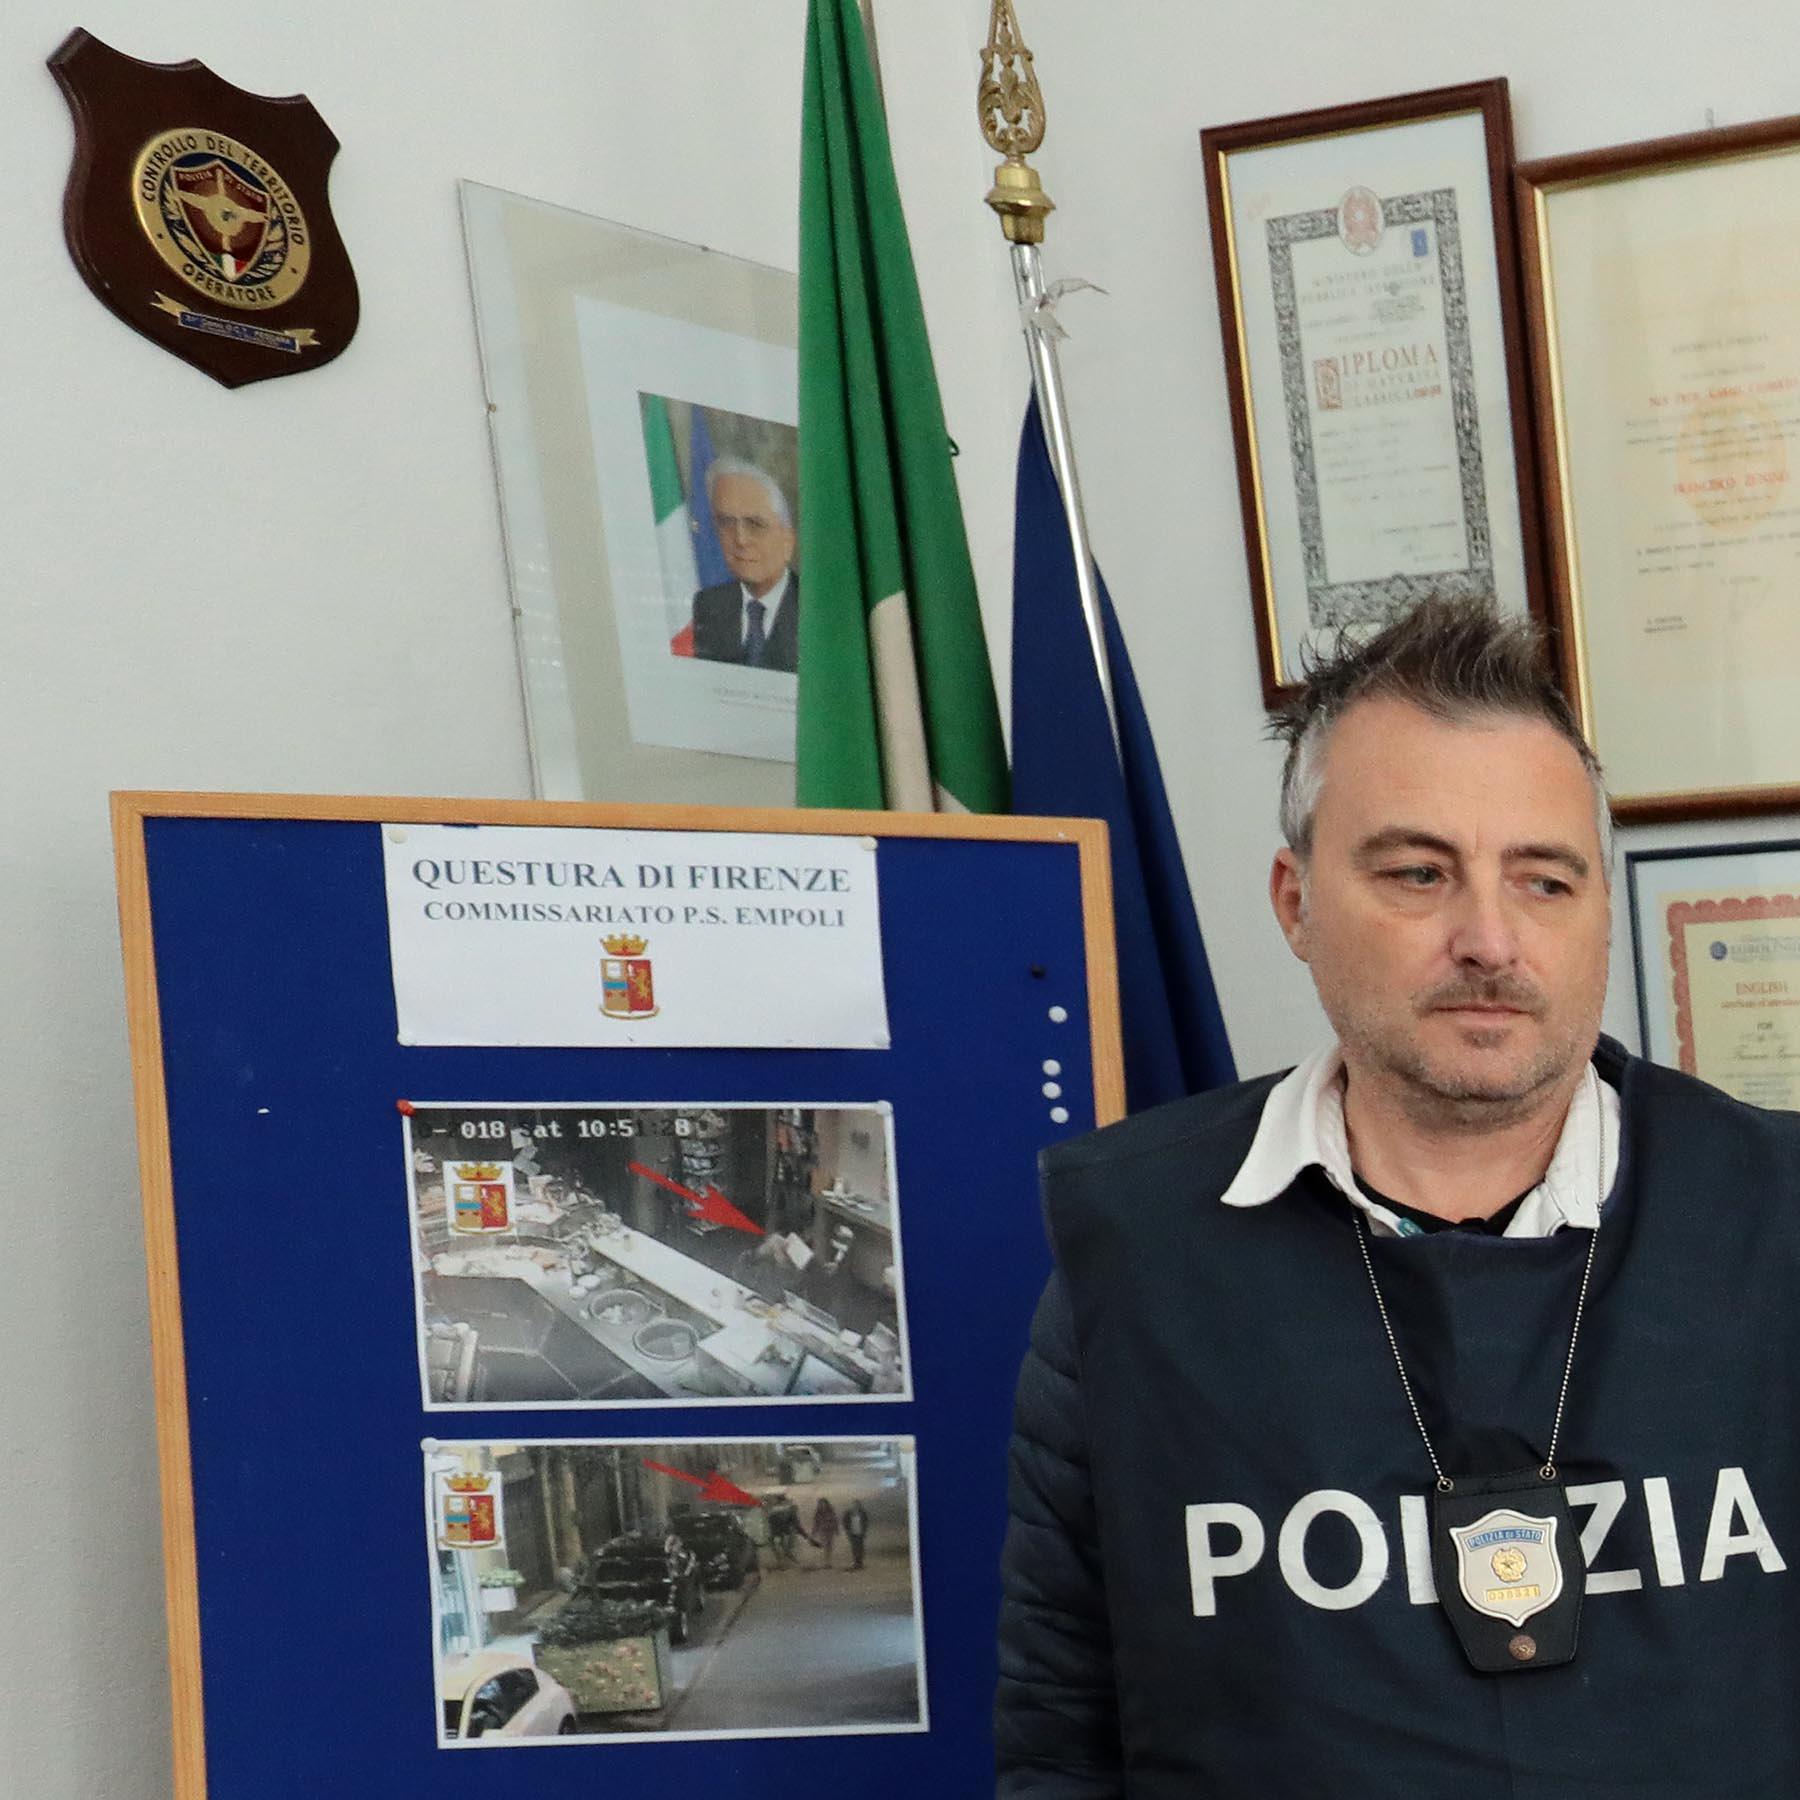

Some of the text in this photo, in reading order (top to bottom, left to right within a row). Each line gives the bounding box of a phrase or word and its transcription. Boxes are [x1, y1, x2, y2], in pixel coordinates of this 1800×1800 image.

[142, 134, 304, 246] CONTROLLO DEL TERRITORIO
[182, 262, 277, 303] OPERATORE
[412, 857, 852, 893] QUESTURA DI FIRENZE
[423, 901, 846, 928] COMMISSARIATO P.S. EMPOLI
[1184, 1466, 1788, 1617] POLZIA
[1469, 1531, 1505, 1549] POLIZIA
[1516, 1529, 1541, 1541] STATO
